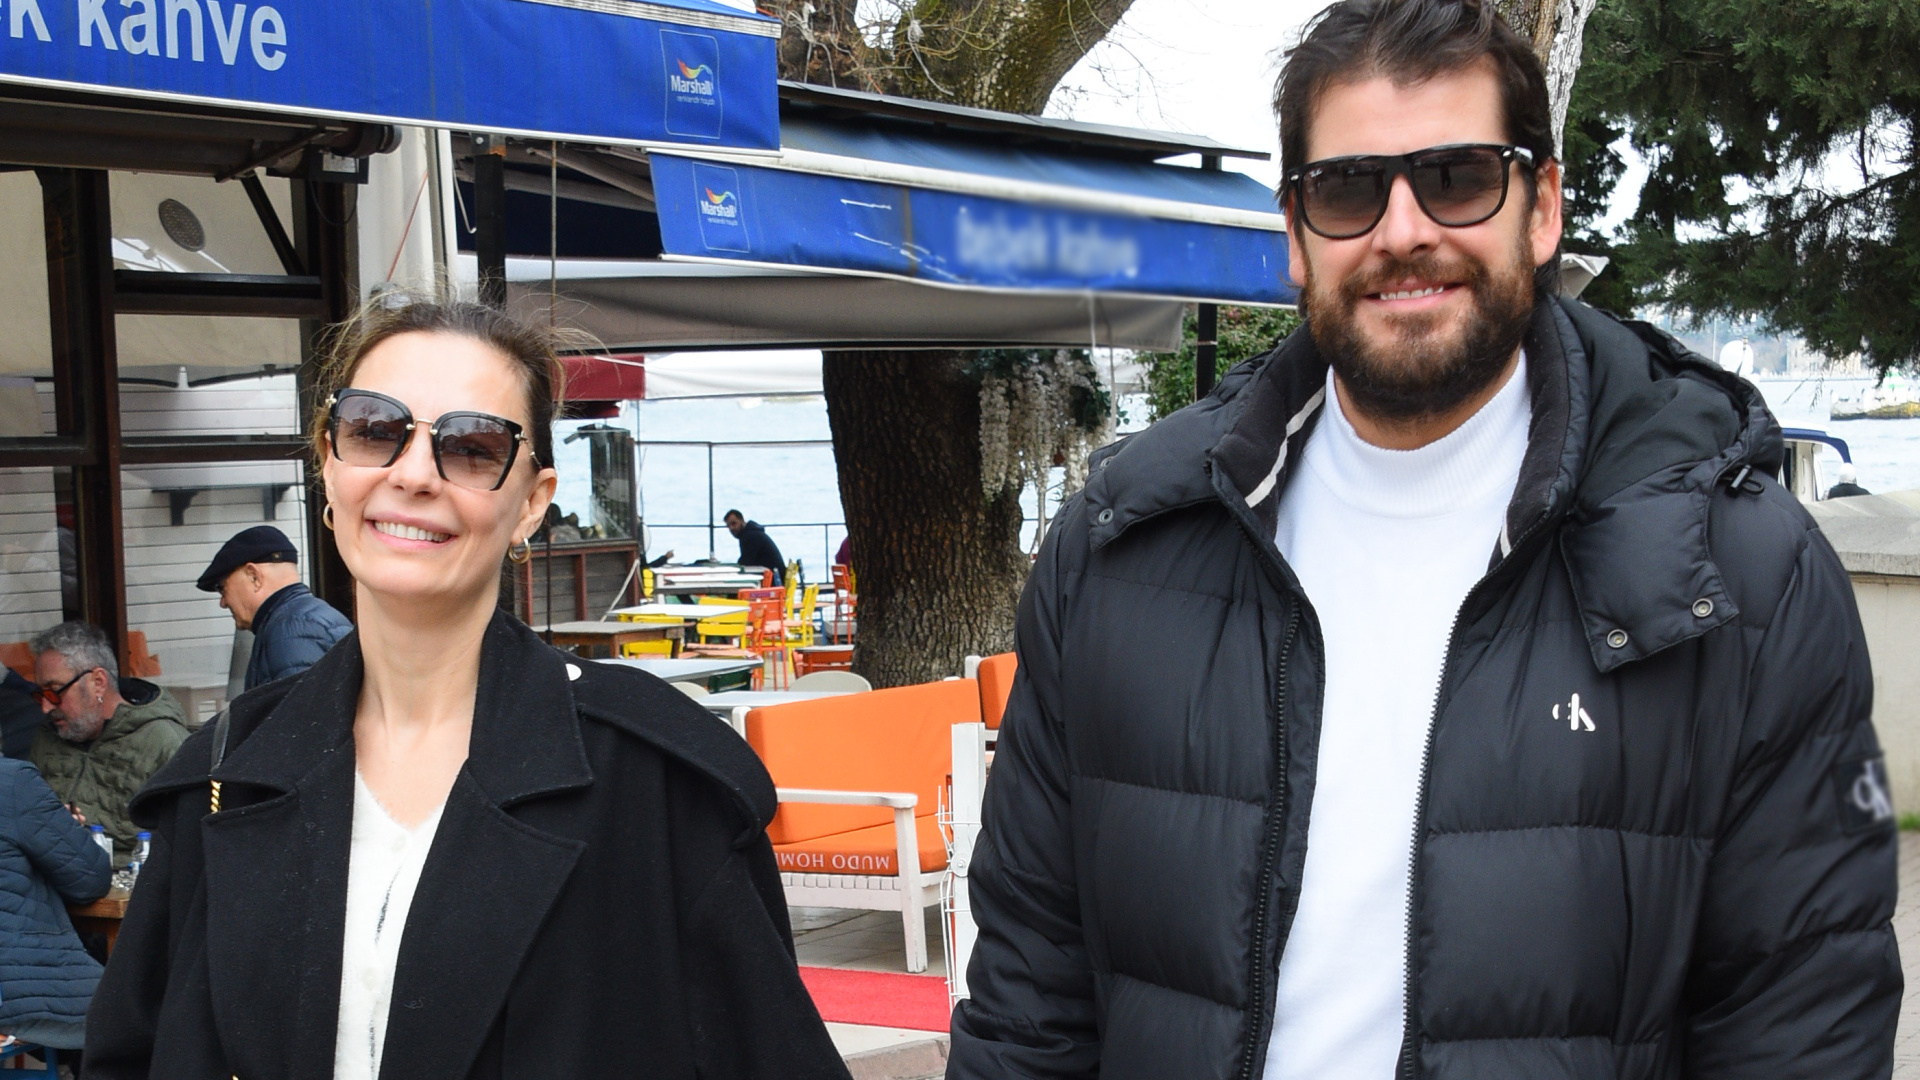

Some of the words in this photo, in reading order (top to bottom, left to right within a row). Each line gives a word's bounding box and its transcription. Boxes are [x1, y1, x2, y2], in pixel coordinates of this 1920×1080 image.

[0, 0, 52, 42] k
[671, 74, 713, 96] Marshall
[701, 200, 736, 218] Marshall
[832, 854, 890, 870] MUDO
